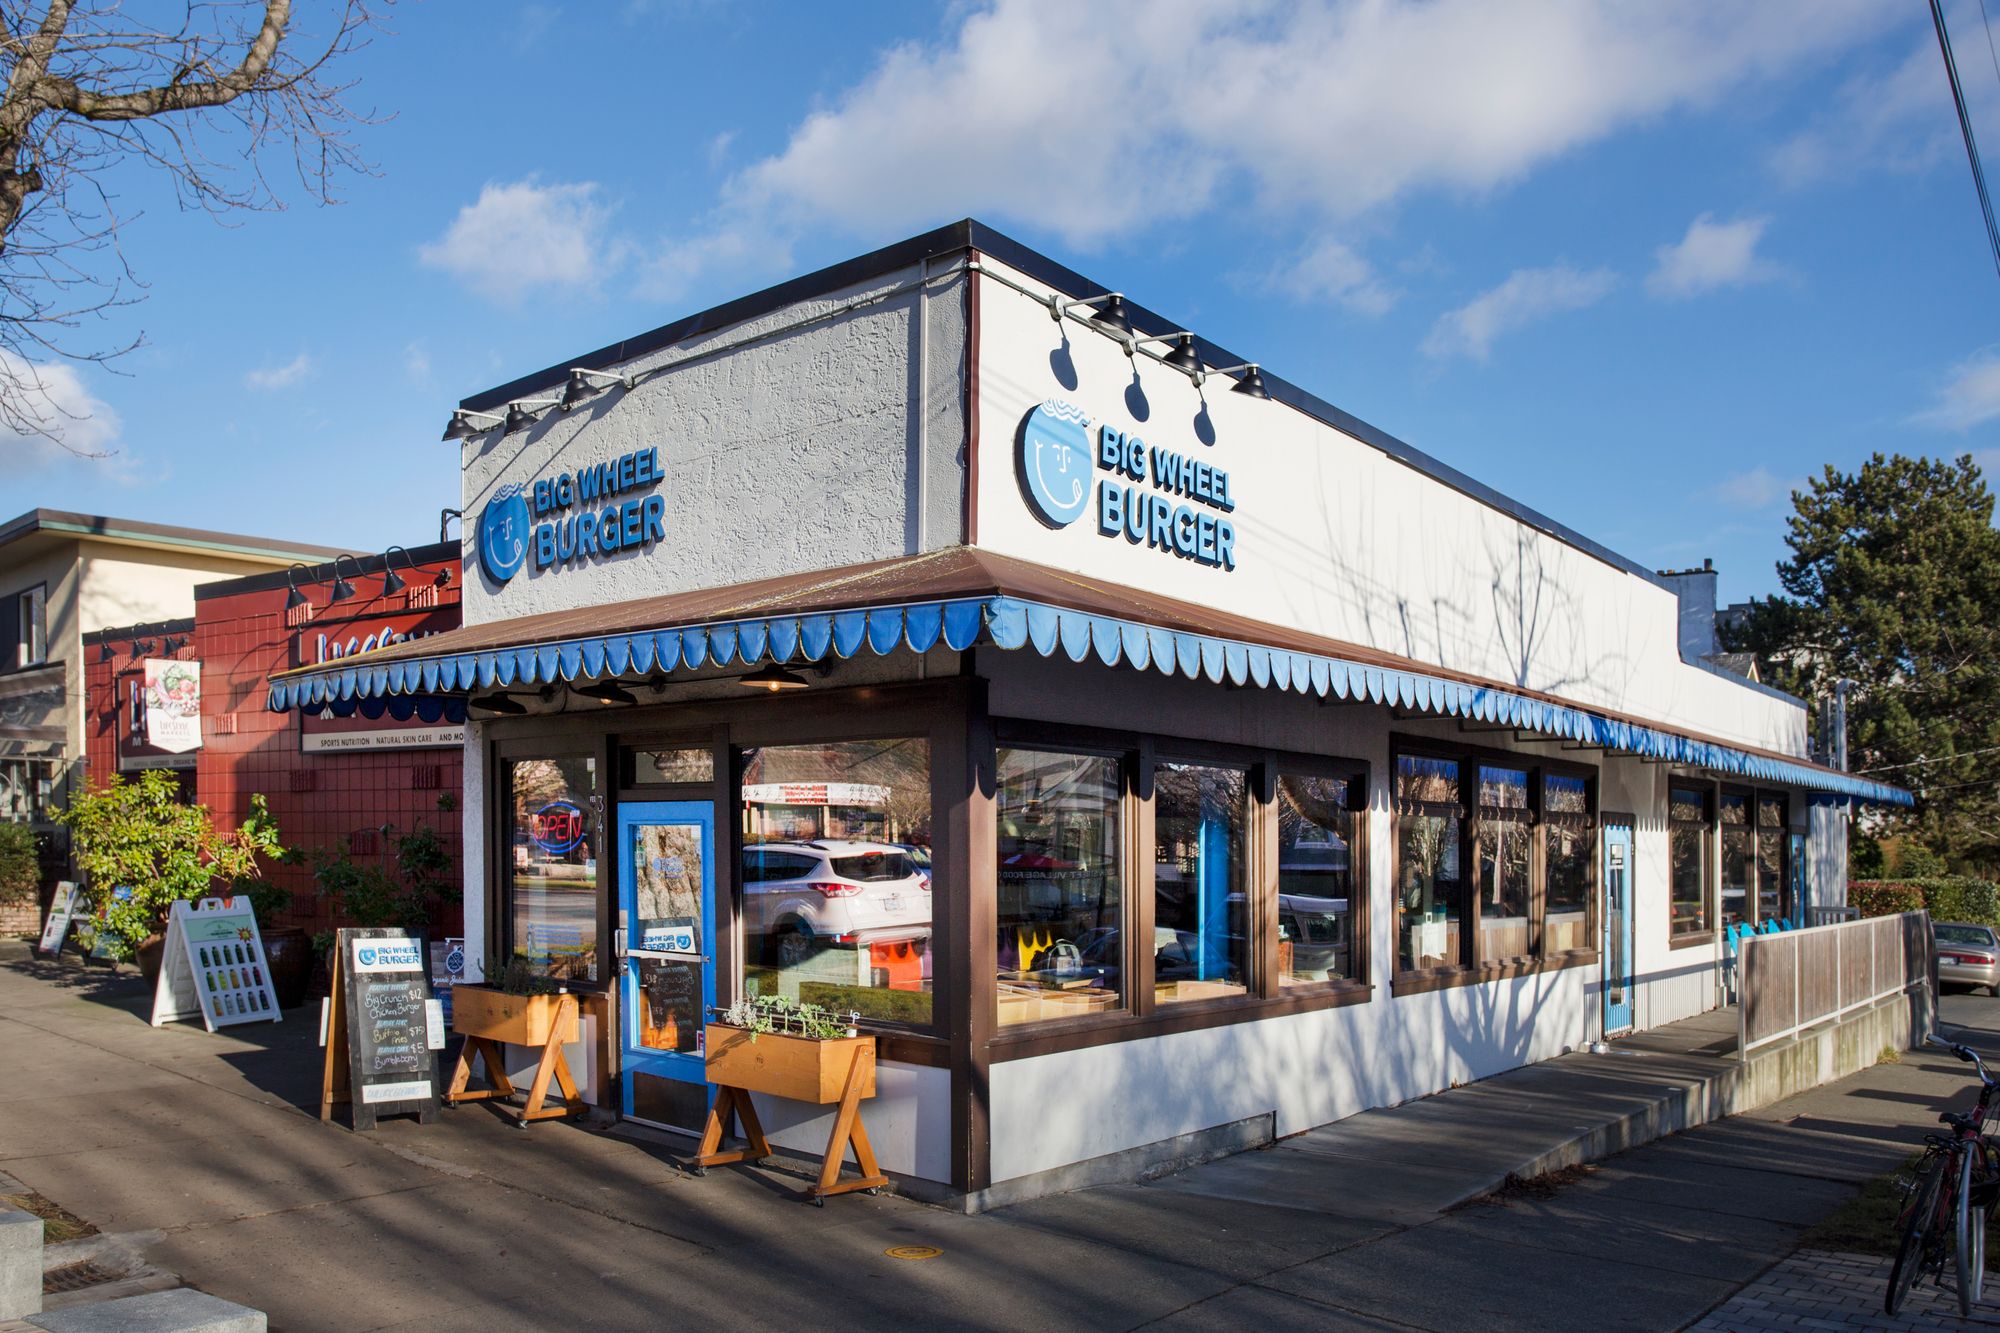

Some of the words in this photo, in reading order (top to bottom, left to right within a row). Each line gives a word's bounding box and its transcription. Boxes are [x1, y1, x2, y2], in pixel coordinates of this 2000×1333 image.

[1097, 424, 1146, 482] BIG
[1150, 446, 1235, 513] WHEEL
[533, 473, 574, 518] BIG
[577, 447, 665, 504] WHEEL
[535, 494, 666, 571] BURGER
[1097, 480, 1236, 572] BURGER
[320, 739, 341, 747] SPORTS
[341, 737, 370, 746] NUTRITION
[376, 736, 401, 744] NATURAL
[402, 735, 416, 743] SKIN
[417, 734, 432, 742] CARE
[439, 733, 453, 741] AND
[533, 814, 583, 839] OPEN
[378, 946, 392, 954] BIG
[393, 946, 418, 954] WHEEL
[379, 955, 419, 964] BURGER
[364, 993, 380, 1009] Big
[379, 993, 408, 1005] Crunch
[408, 988, 422, 1000] $12
[369, 1007, 398, 1019] Chicken
[397, 1003, 421, 1014] Burger
[410, 1042, 425, 1054] $5
